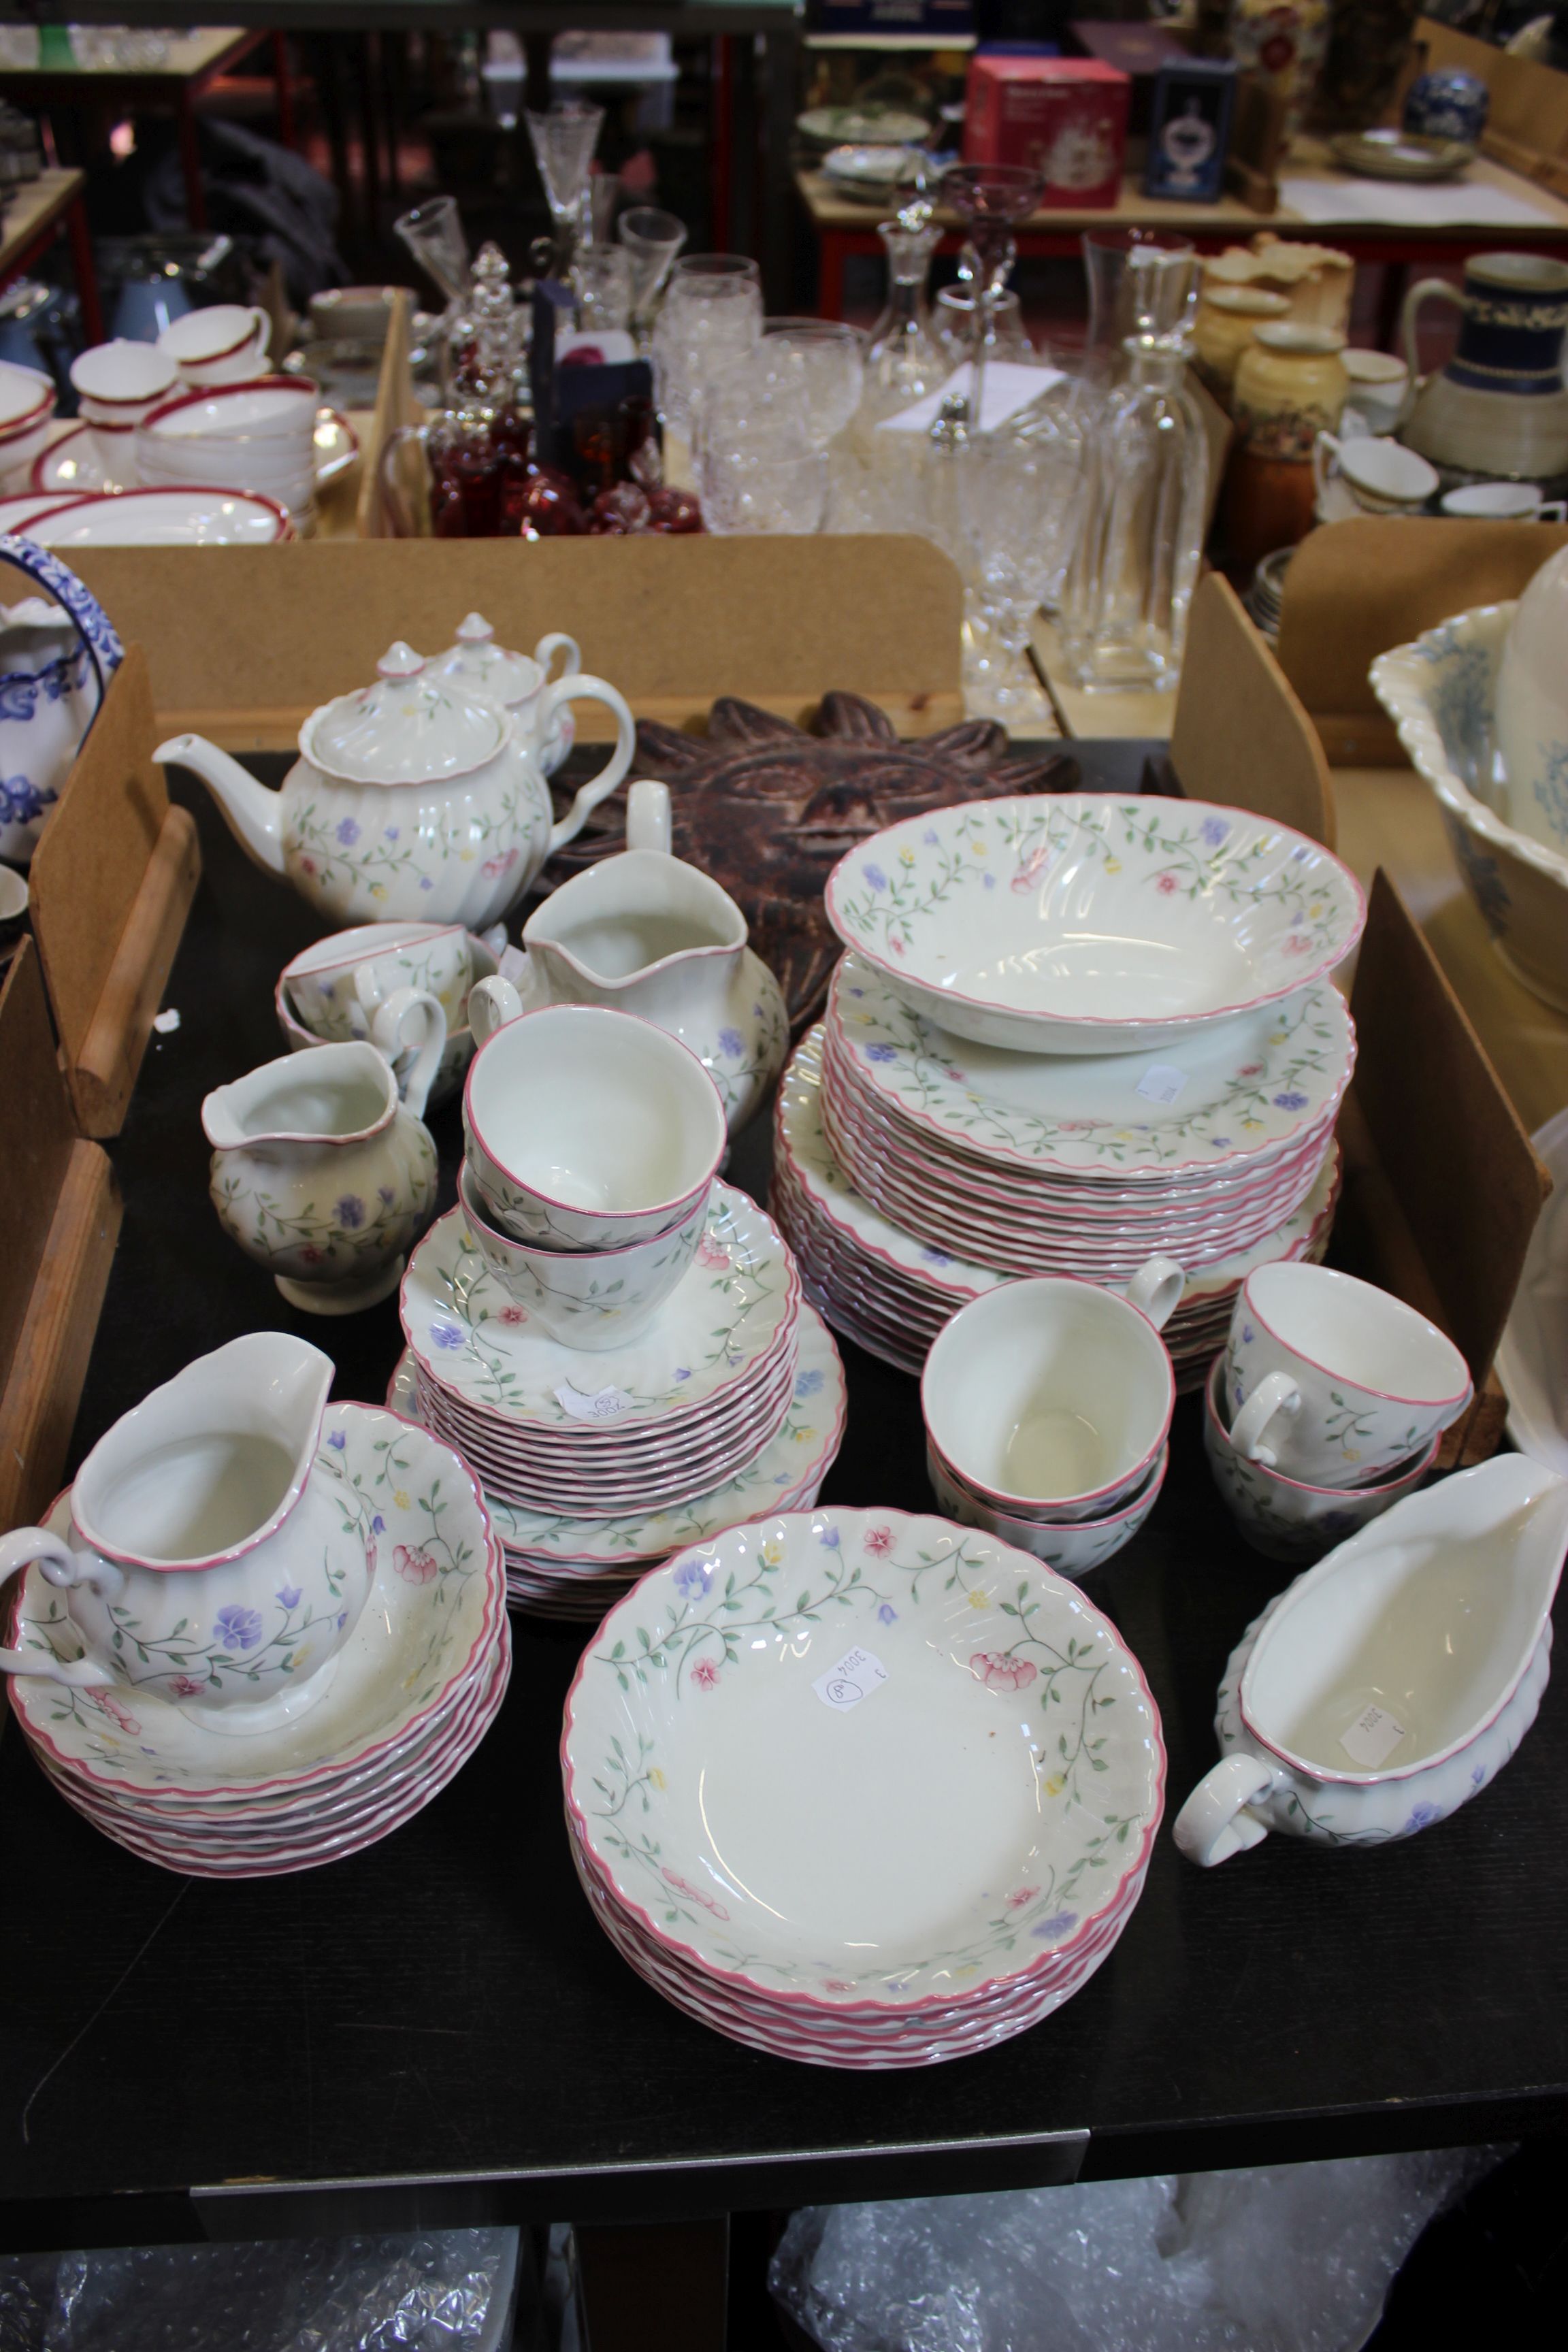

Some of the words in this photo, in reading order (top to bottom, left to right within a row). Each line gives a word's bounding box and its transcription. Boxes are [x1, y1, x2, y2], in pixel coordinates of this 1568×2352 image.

[838, 1650, 866, 1676] 3004
[875, 1669, 887, 1679] 3
[1359, 1708, 1383, 1732] 3004
